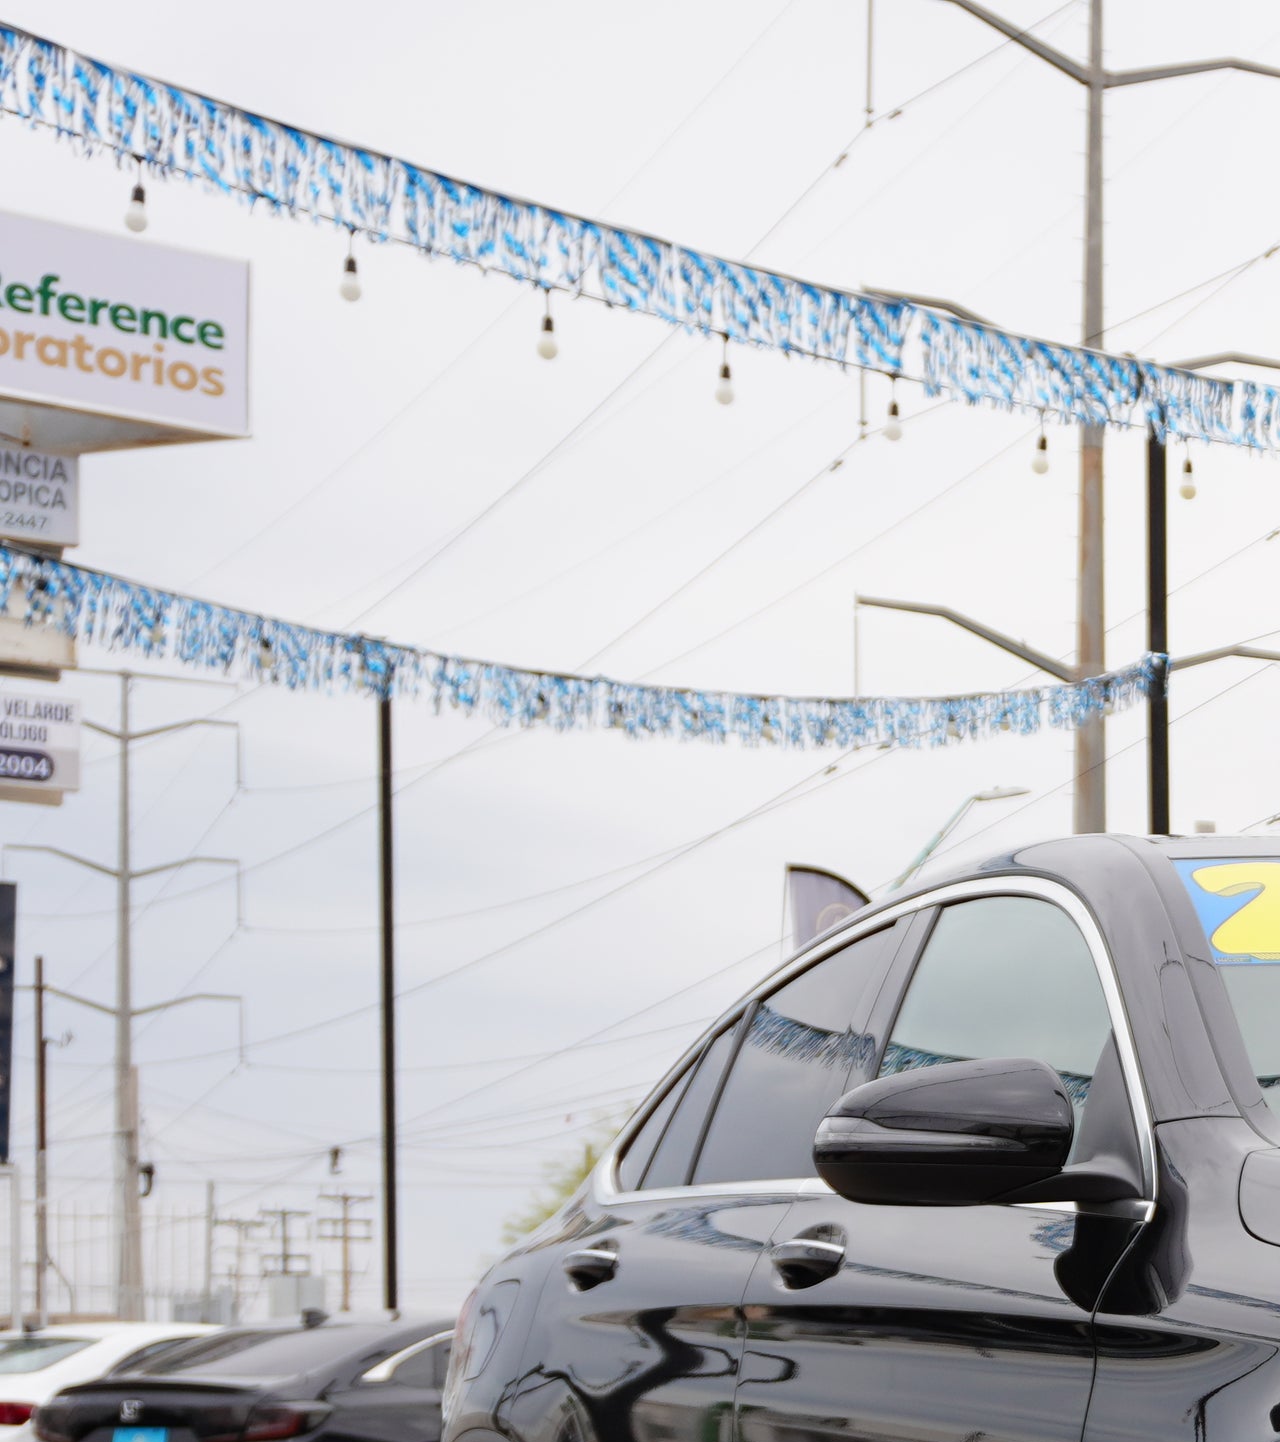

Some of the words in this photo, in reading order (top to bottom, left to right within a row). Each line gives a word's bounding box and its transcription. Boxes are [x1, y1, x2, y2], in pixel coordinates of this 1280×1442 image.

[0, 271, 225, 350] eference
[0, 451, 68, 483] NCIA
[4, 698, 74, 723] VELARDE
